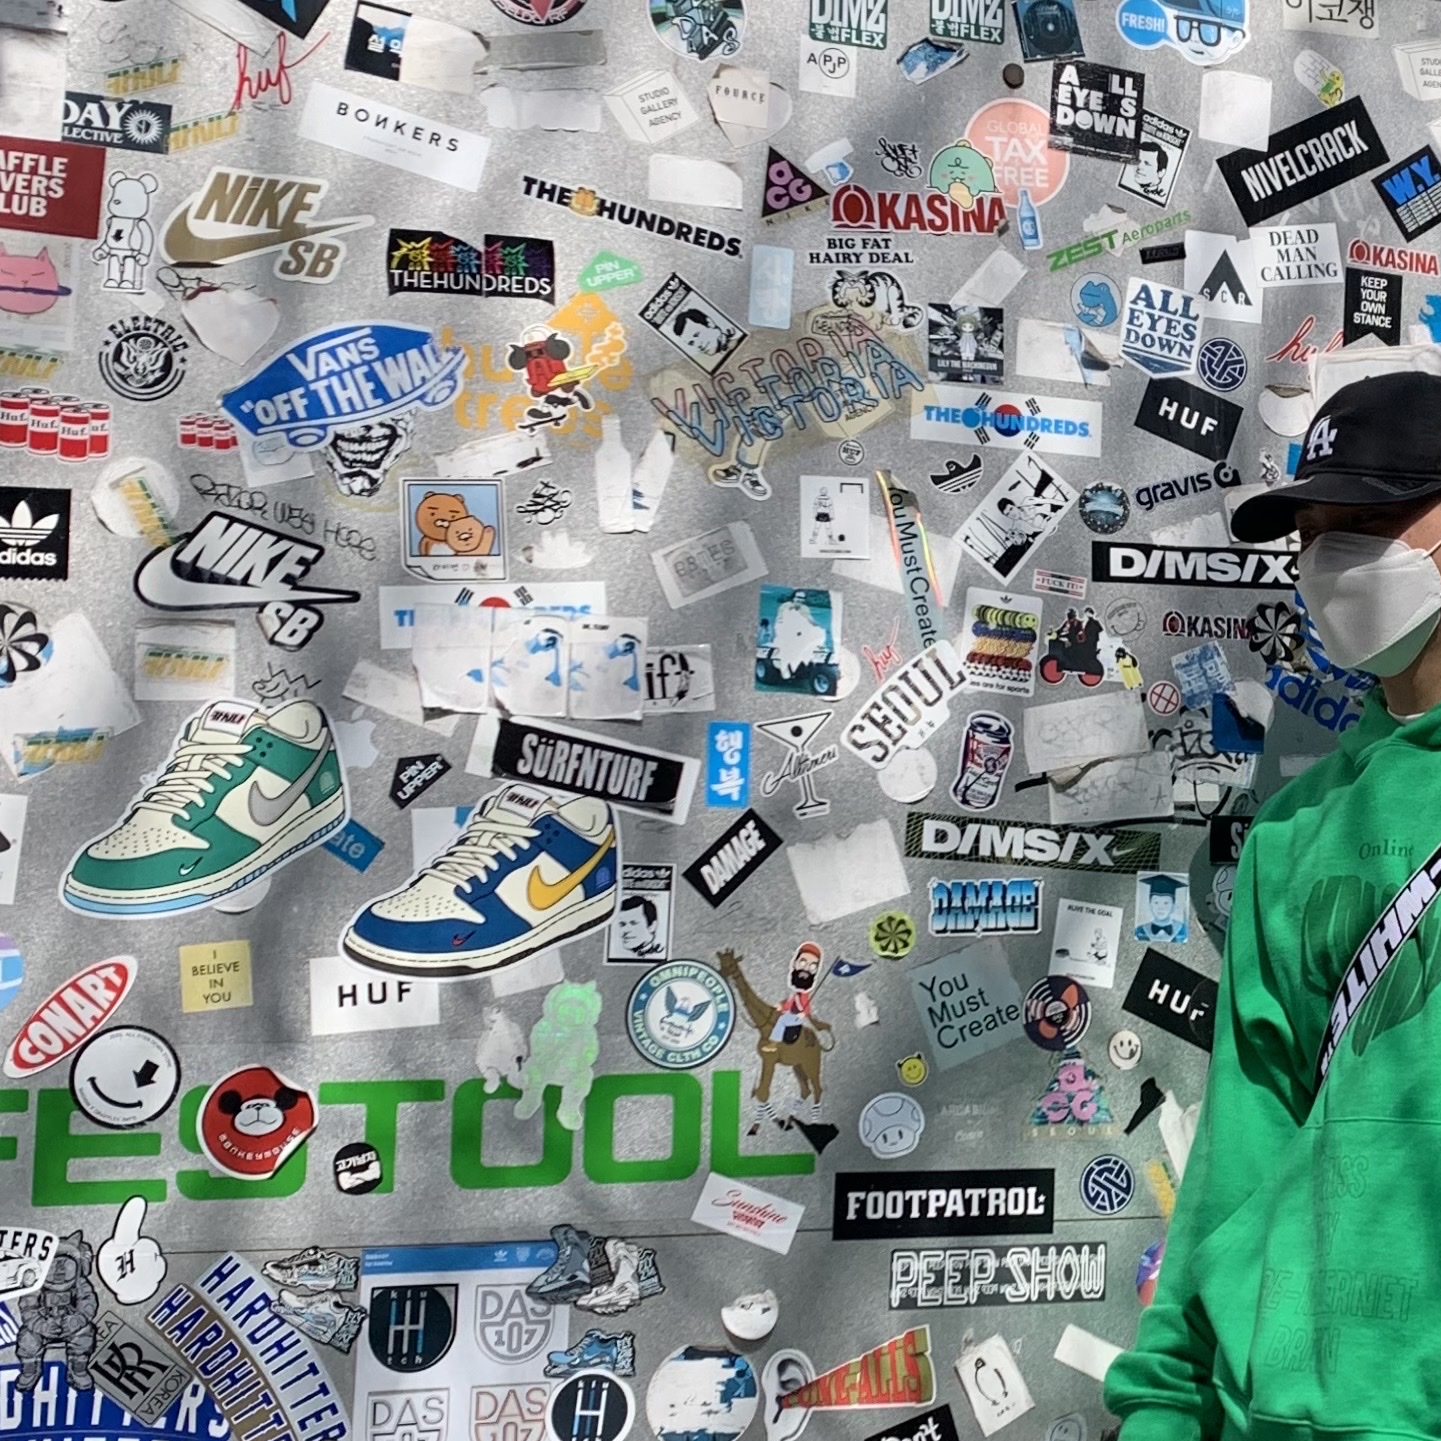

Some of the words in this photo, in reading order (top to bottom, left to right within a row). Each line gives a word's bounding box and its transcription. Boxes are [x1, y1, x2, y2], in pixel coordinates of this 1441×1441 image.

[841, 30, 885, 48] FLEX
[959, 26, 1002, 44] FLEX
[639, 87, 670, 103] STUDIO
[640, 96, 678, 115] GALLERY
[648, 111, 682, 128] AGENCY
[987, 119, 1045, 136] GLOBAL
[1057, 107, 1138, 139] DOWN
[985, 136, 1048, 165] TAX
[1240, 120, 1369, 202] NIVELCRACK
[994, 167, 1049, 188] FREE
[523, 175, 572, 208] THE
[598, 193, 742, 258] HUNDREDS
[826, 238, 857, 250] BIG
[861, 238, 892, 250] FAT
[1046, 230, 1120, 272] ZEST
[1122, 208, 1193, 245] Aeroparts
[1269, 228, 1320, 247] DEAD
[279, 238, 340, 279] SB
[595, 259, 621, 275] PIN
[809, 251, 864, 265] HAIRY
[867, 251, 914, 265] DEAL
[1276, 246, 1318, 264] MAN
[1369, 250, 1439, 276] KASINA
[586, 265, 634, 288] UPPER
[1260, 262, 1339, 282] CALLING
[1361, 276, 1388, 289] KEEP
[1130, 282, 1200, 323] ALL
[1360, 288, 1388, 302] YOUR
[1360, 301, 1386, 315] OWN
[104, 314, 190, 354] ELECTRIC
[1126, 304, 1198, 341] EYES
[1353, 312, 1392, 329] STANCE
[287, 327, 379, 382] VANS
[1125, 327, 1195, 360] DOWN
[311, 365, 374, 415] THE
[924, 405, 964, 425] THE
[979, 409, 1090, 438] HUNDREDS
[1159, 397, 1219, 438] HUF
[1136, 472, 1213, 512] gravis
[177, 514, 319, 590] NIKE
[896, 523, 922, 576] Must
[264, 602, 321, 648] SB
[848, 646, 967, 766] SEOUL
[397, 761, 444, 800] UPPER
[700, 821, 768, 897] DAMAGE
[932, 880, 1040, 935] DAMAGE
[191, 961, 241, 977] BELIEVE
[208, 978, 224, 989] IN
[203, 991, 232, 1005] YOU
[337, 982, 412, 1008] HUF
[919, 971, 969, 1004] You
[18, 964, 124, 1065] CONART
[928, 988, 991, 1030] Must
[936, 1001, 1020, 1052] Create
[846, 1186, 1044, 1220] FOOTPATROL
[891, 1248, 995, 1308] PEEP
[1005, 1244, 1105, 1300] SHOW
[372, 1397, 445, 1427] DAS
[475, 1387, 548, 1417] DAS
